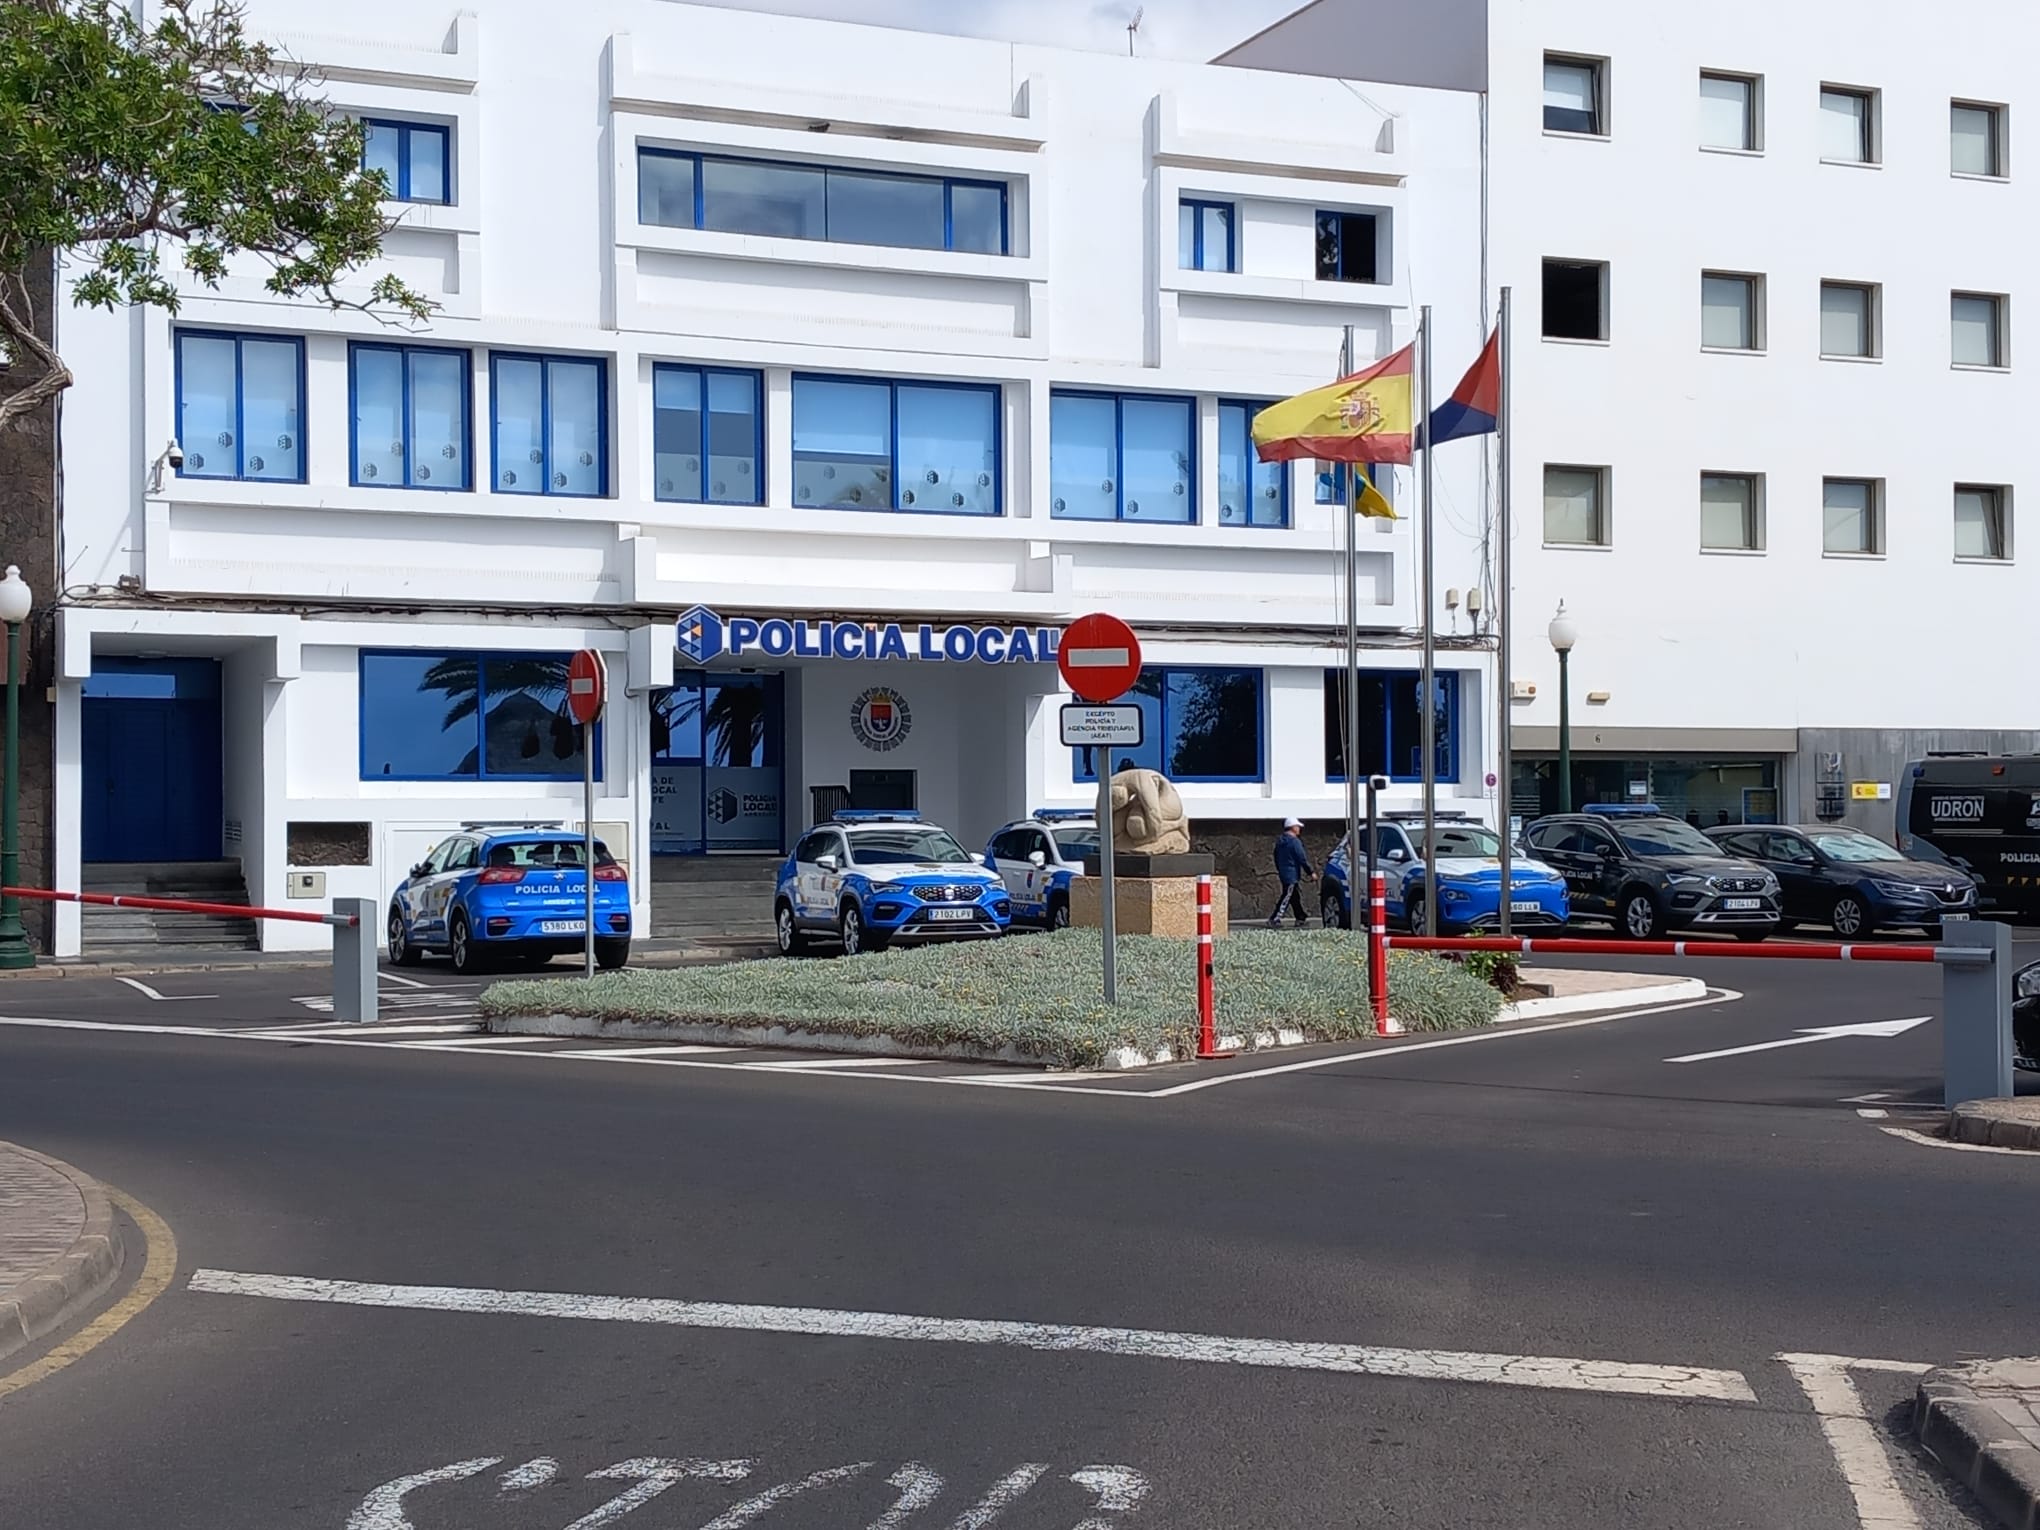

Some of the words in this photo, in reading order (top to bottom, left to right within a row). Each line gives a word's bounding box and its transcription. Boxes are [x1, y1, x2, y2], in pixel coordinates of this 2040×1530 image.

[918, 624, 1059, 664] LOCAL
[743, 802, 777, 811] LOCAL
[1931, 800, 1985, 817] UDRON
[515, 885, 560, 894] POLICIA
[566, 884, 600, 893] LOCL
[934, 910, 954, 918] 2102
[955, 910, 972, 918] LPV
